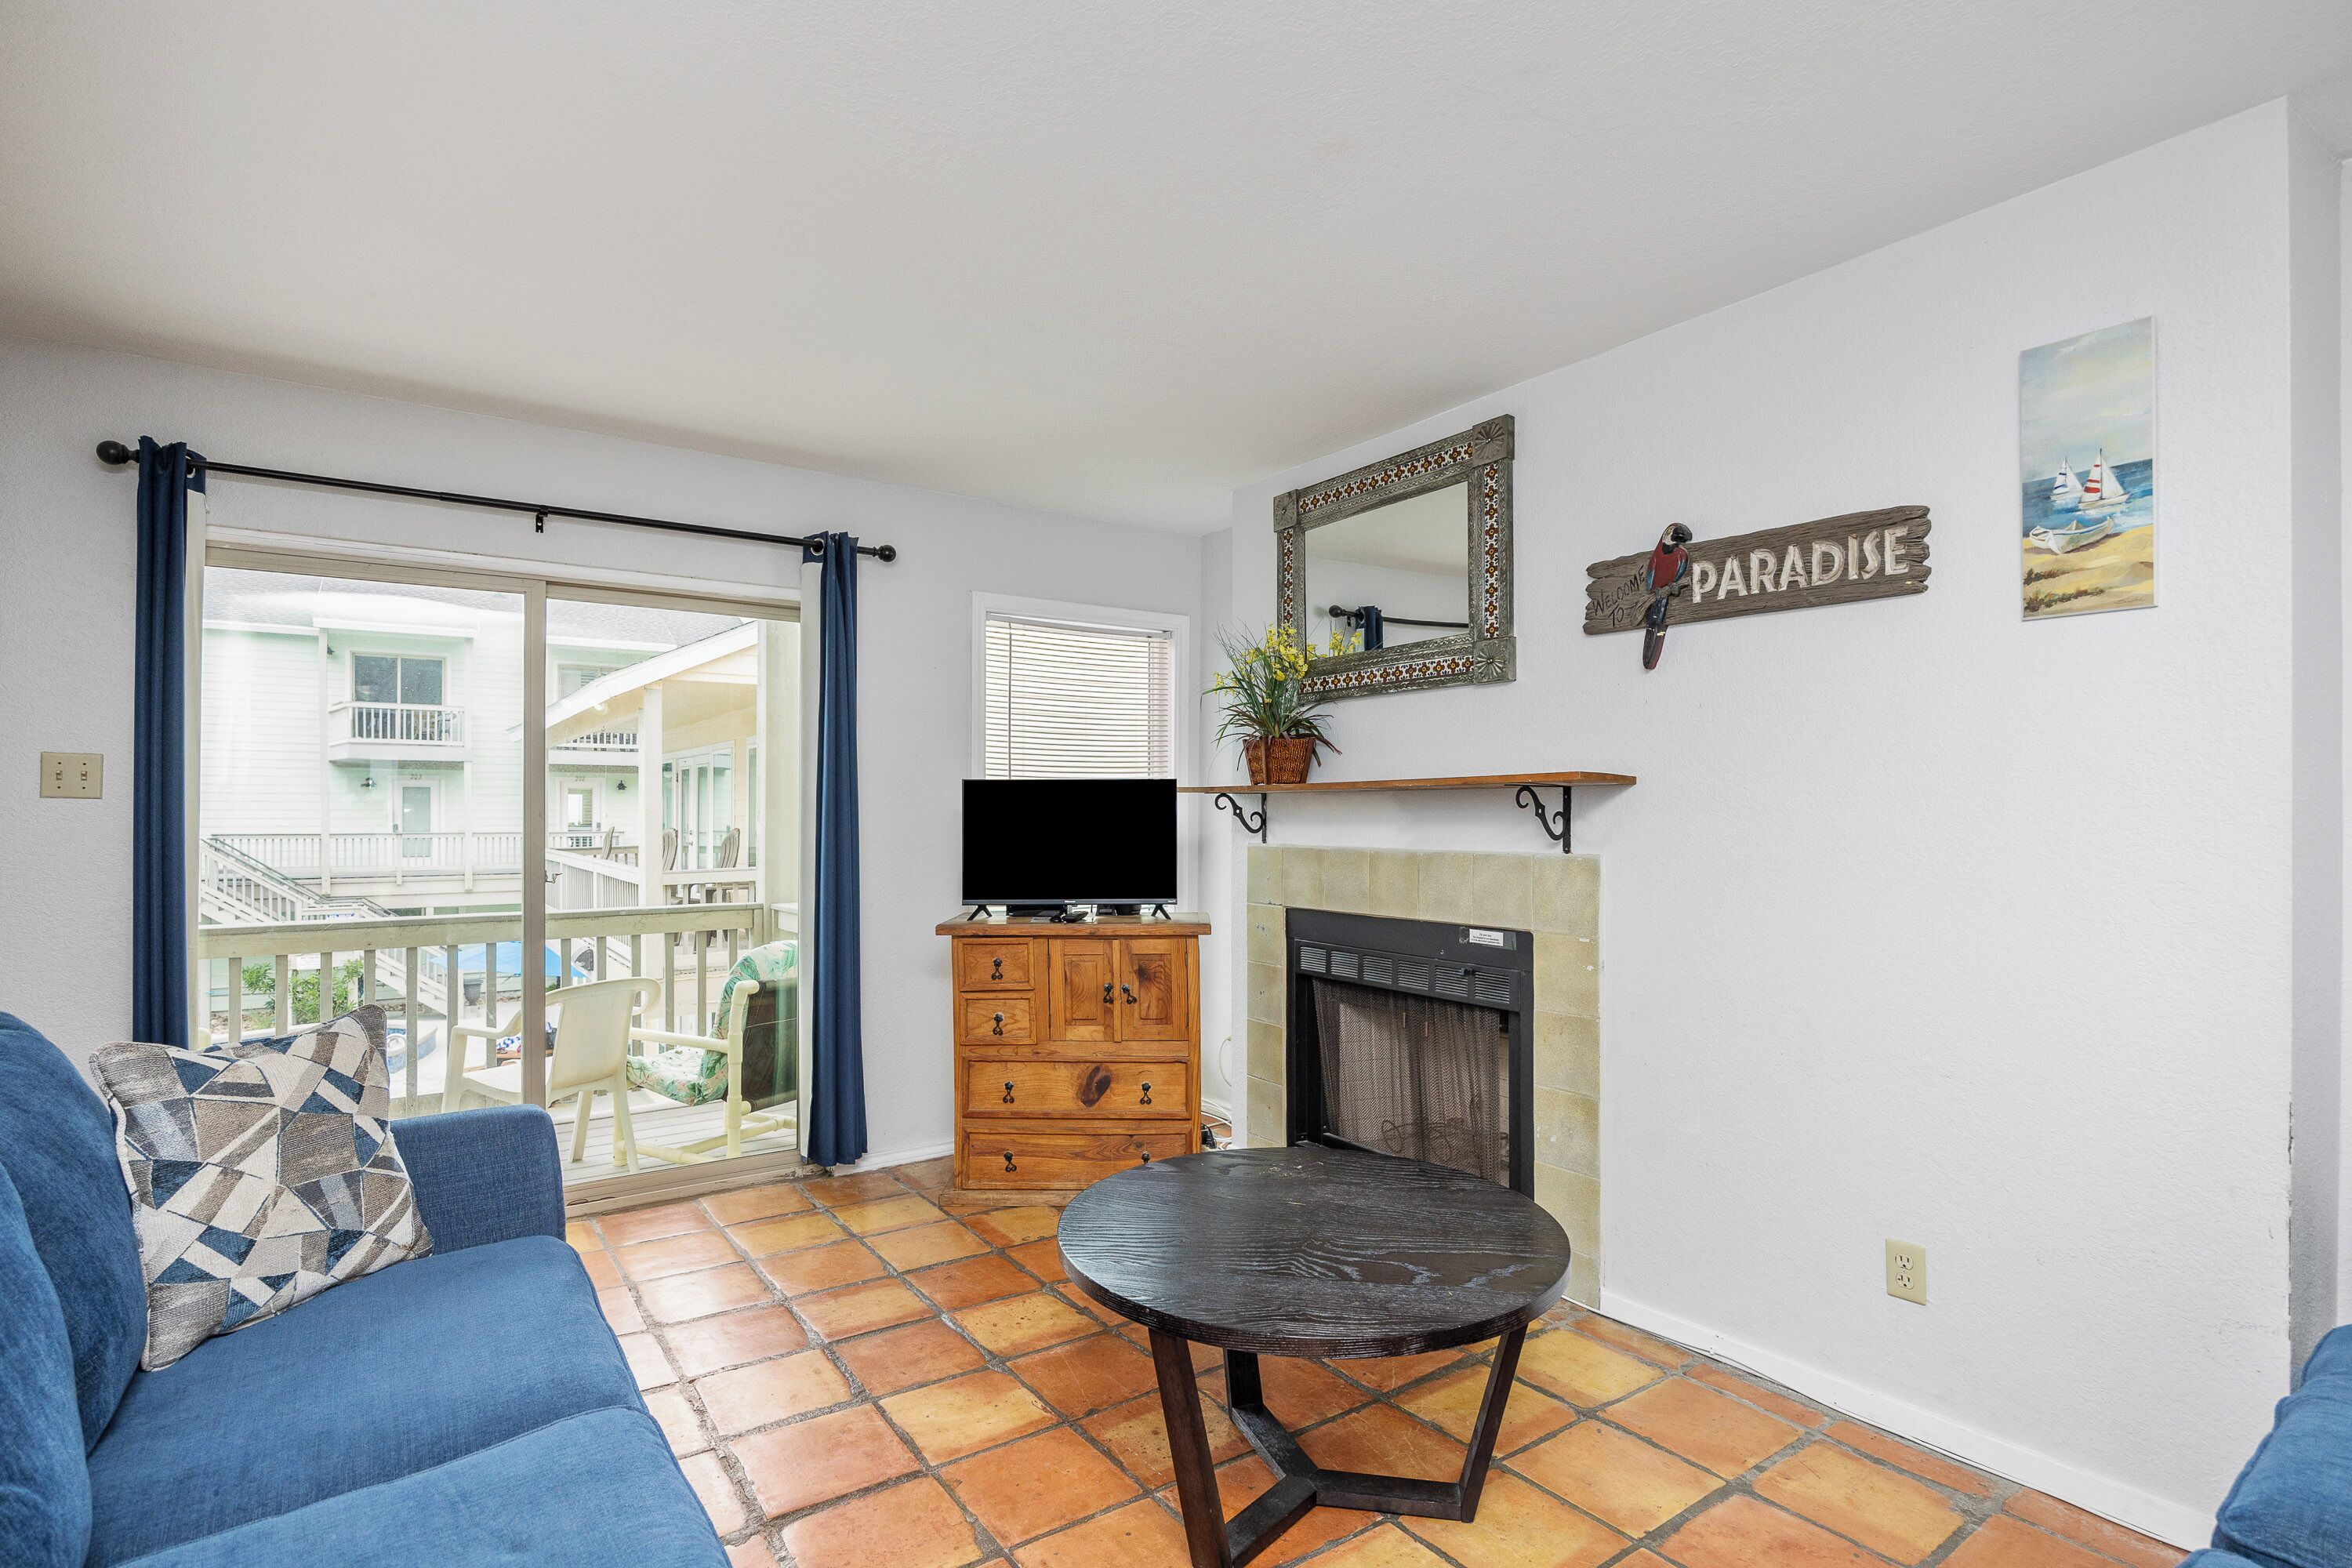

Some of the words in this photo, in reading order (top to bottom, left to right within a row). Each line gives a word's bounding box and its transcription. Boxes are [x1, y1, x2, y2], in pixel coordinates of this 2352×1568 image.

[1592, 564, 1646, 615] WELCOME
[1691, 525, 1910, 604] PARADISE
[1608, 604, 1624, 629] TO
